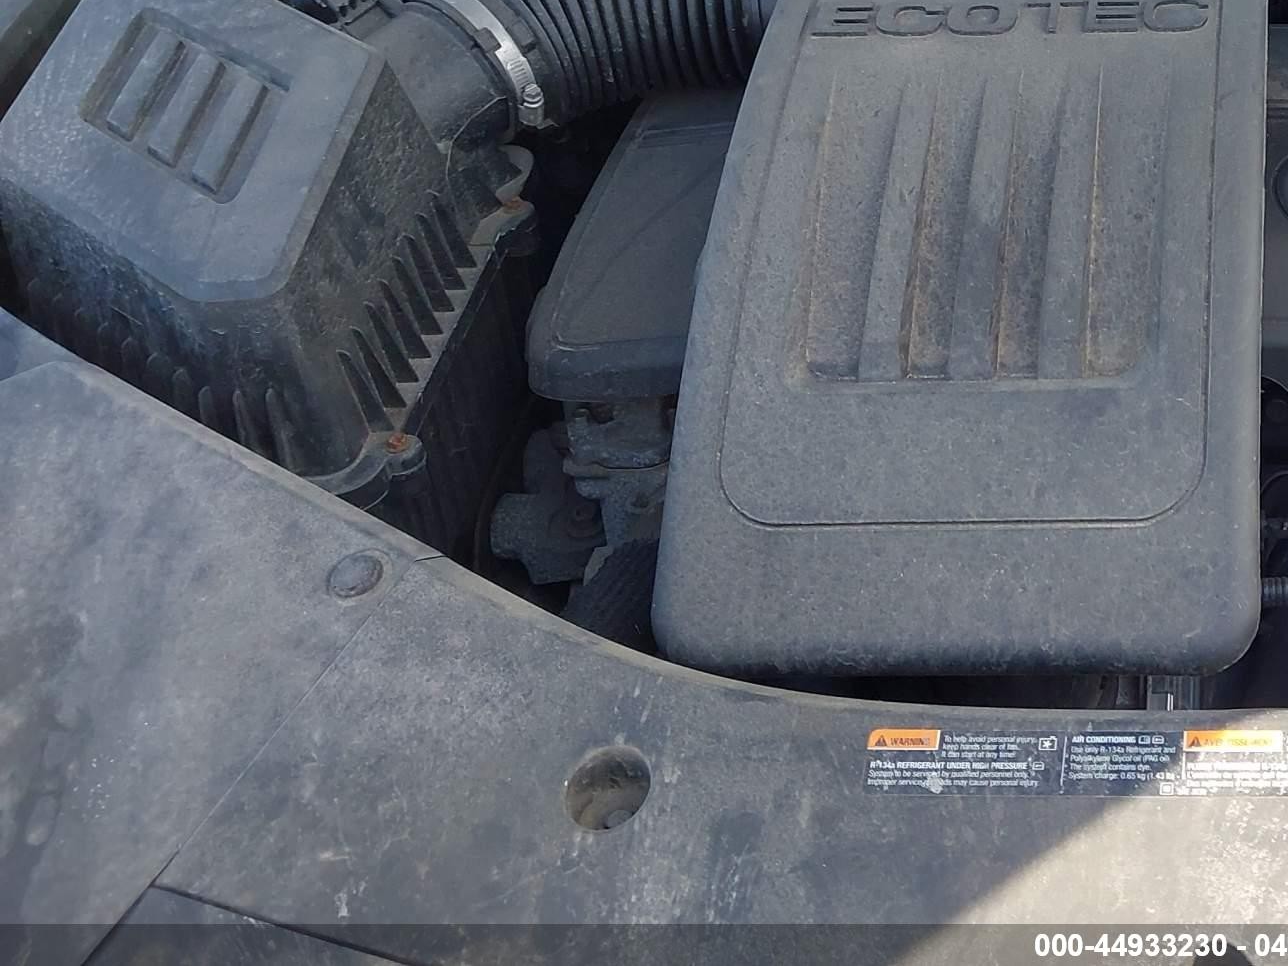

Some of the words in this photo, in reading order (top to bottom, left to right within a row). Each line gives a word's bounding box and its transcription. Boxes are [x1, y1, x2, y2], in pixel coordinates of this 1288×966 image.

[810, 0, 1209, 37] ECOTEC
[953, 735, 967, 744] help
[968, 735, 986, 743] avoid
[987, 735, 1016, 744] personal
[1071, 735, 1085, 743] AIR
[1085, 735, 1137, 744] CONDITIONING
[943, 743, 959, 752] keep
[960, 743, 980, 751] hands
[981, 743, 998, 751] clear
[1071, 745, 1084, 754] Use
[1084, 745, 1100, 755] only
[1100, 745, 1125, 754] R-134a
[1125, 745, 1162, 755] Refrigerant
[1162, 745, 1176, 754] and
[985, 751, 997, 760] any
[1111, 754, 1133, 764] Glycol
[896, 761, 945, 769] REFRIGERANT
[946, 761, 971, 770] UNDER
[972, 761, 990, 769] HIGH
[991, 761, 1028, 770] PRESSURE
[1070, 763, 1082, 771] The
[1083, 763, 1108, 773] system
[1107, 763, 1137, 771] contains
[869, 769, 894, 779] System
[902, 769, 912, 778] be
[941, 770, 952, 779] by
[951, 769, 980, 778] qualified
[980, 770, 1013, 779] personnel
[1068, 771, 1094, 781] System
[1120, 771, 1136, 780] 0.65
[1136, 772, 1146, 782] kg
[867, 778, 897, 787] Improper
[953, 779, 968, 788] may
[968, 779, 989, 787] cause
[989, 779, 1019, 788] personal
